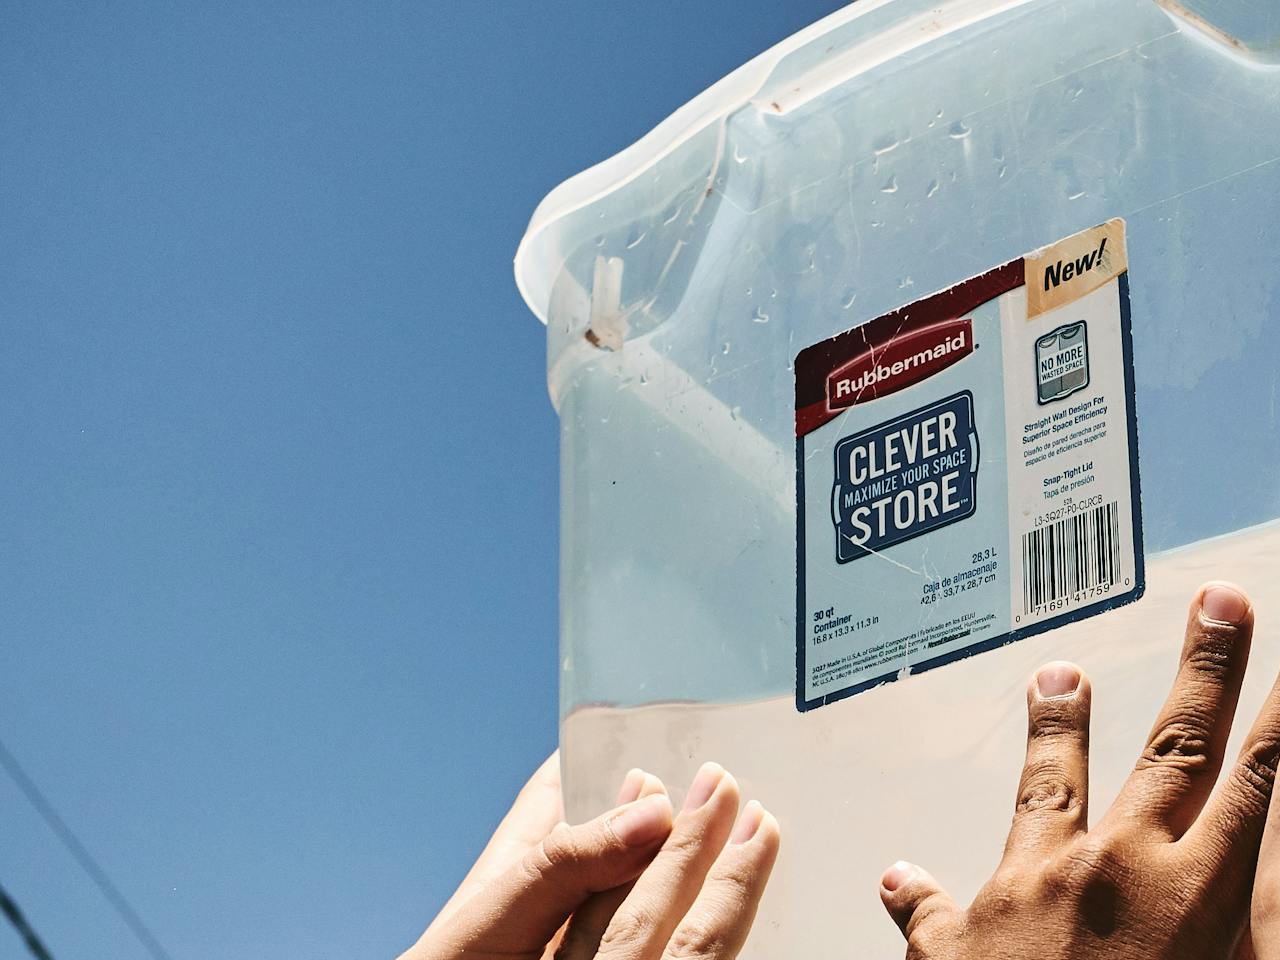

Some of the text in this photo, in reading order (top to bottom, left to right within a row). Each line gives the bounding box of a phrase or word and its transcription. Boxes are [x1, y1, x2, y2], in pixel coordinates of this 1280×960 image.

[1044, 237, 1107, 291] New!
[836, 331, 965, 398] Rubbermaid
[1041, 345, 1083, 373] NO MORE
[1042, 359, 1084, 381] WASTED SPACE
[1022, 406, 1108, 445] Superior Space Efficiency
[1024, 396, 1104, 433] Straight Wall Design For
[850, 411, 957, 485] CLEVER
[1025, 430, 1107, 467] espacio de eficiencia superior
[1044, 442, 1051, 450] de
[1052, 435, 1068, 448] pared
[1069, 427, 1092, 440] derecha
[1093, 421, 1106, 432] para
[844, 449, 966, 508] MAXIMIZE YOUR SPACE
[1043, 460, 1093, 487] Snap-Tight Lid
[1043, 475, 1095, 500] Tapa de presión
[850, 471, 961, 545] STORE
[972, 547, 997, 564] 28,3 L
[923, 560, 998, 594] Caja de almacenaje
[961, 584, 966, 592] x
[984, 573, 996, 583] cm
[813, 606, 834, 622] 30 qt
[1015, 578, 1130, 623] 0 71691 41759 0
[812, 633, 828, 646] 16.8
[835, 625, 849, 638] 13.3
[856, 618, 871, 630] 11.3
[872, 616, 879, 625] in
[814, 614, 853, 634] Container
